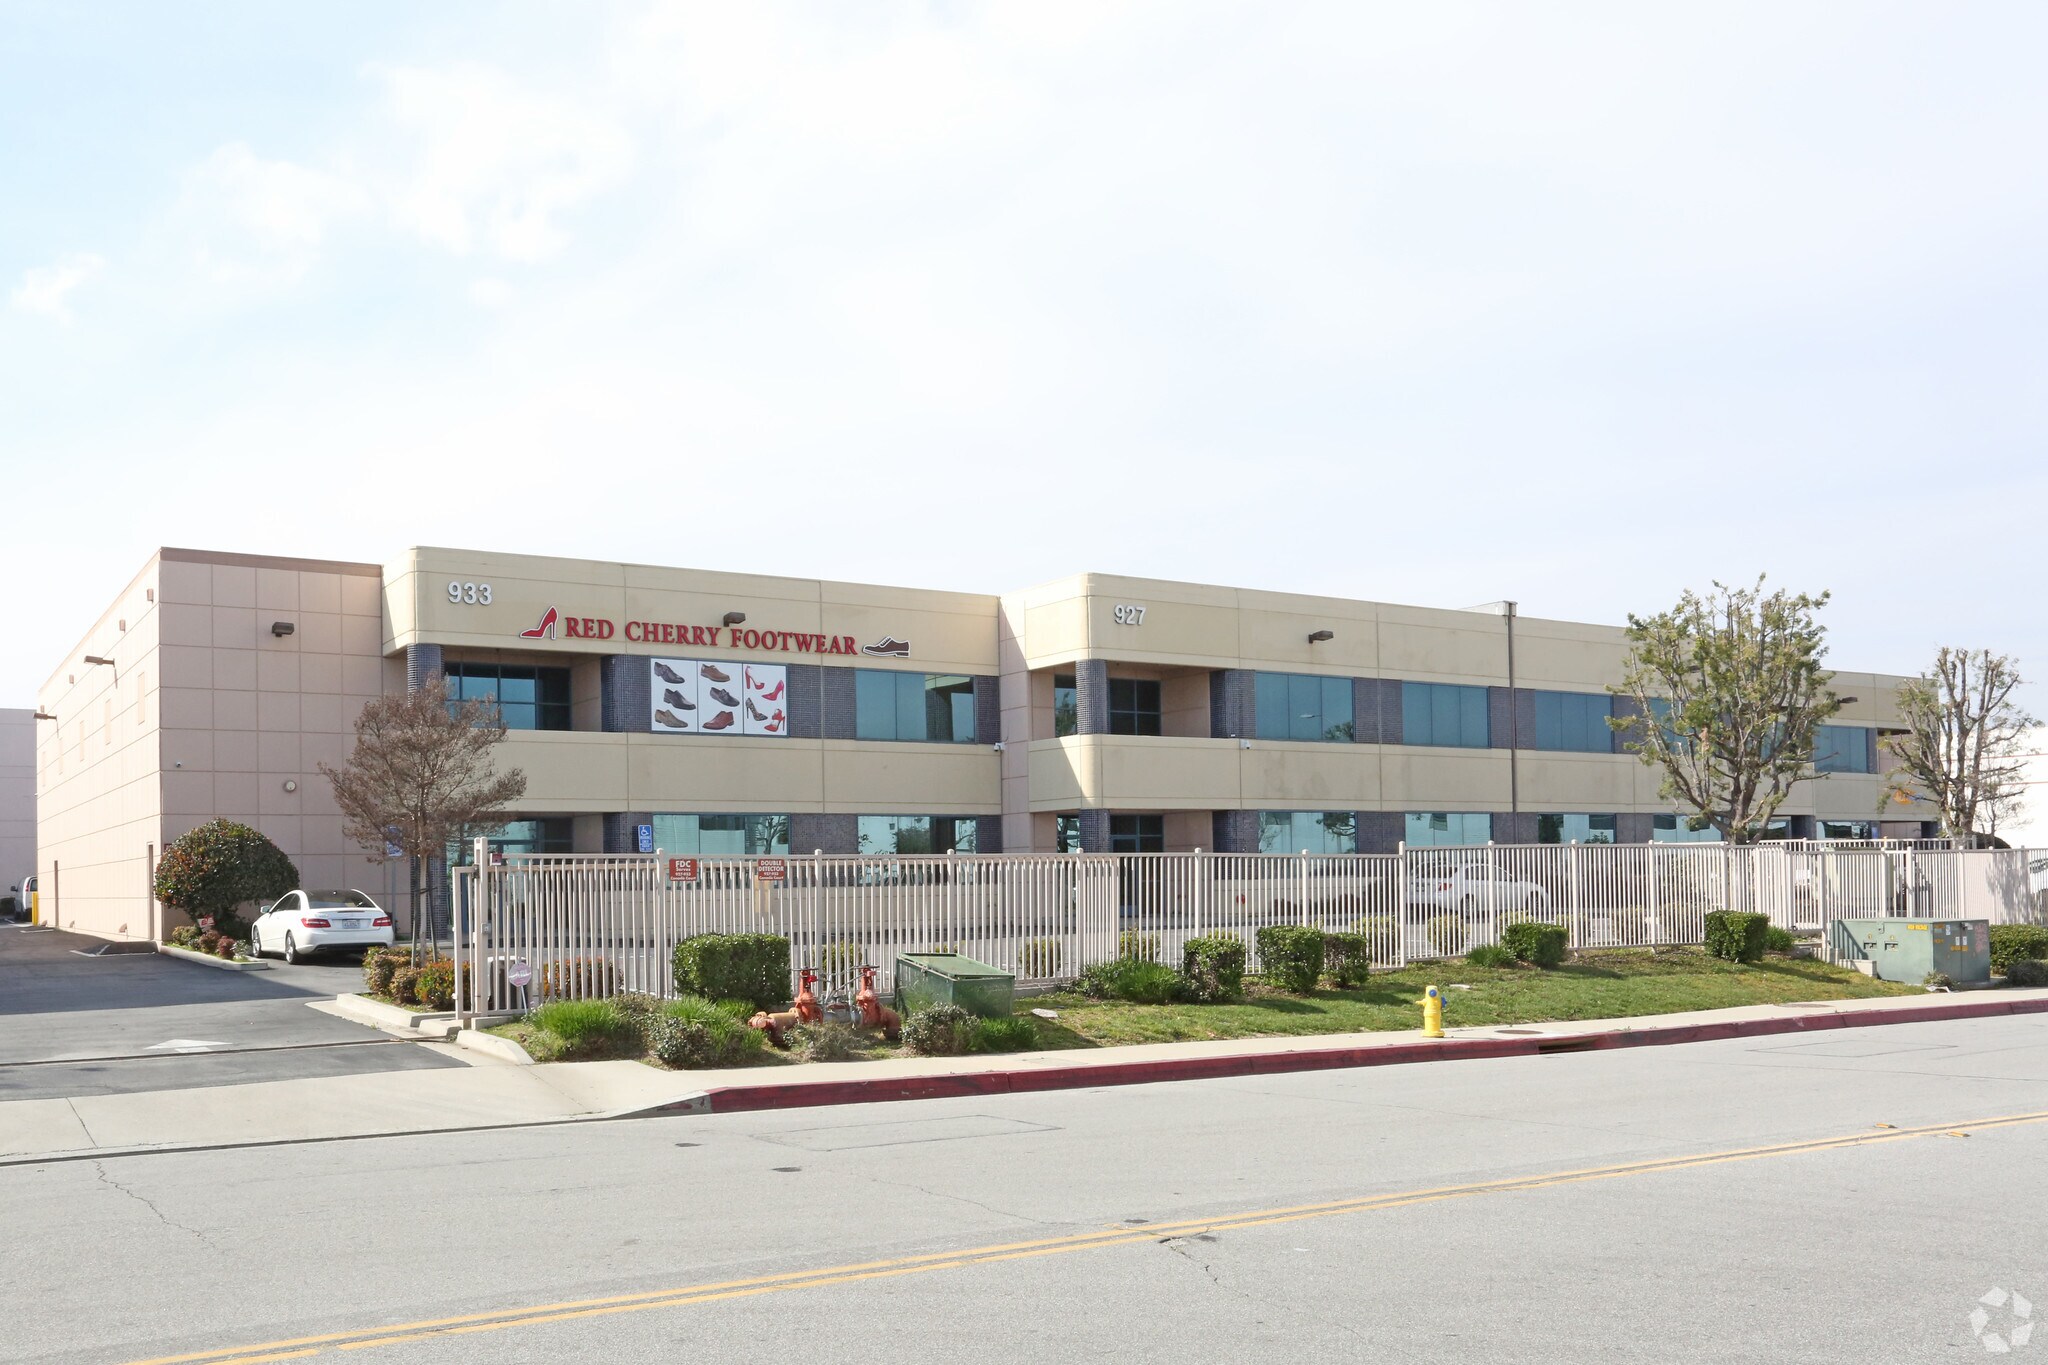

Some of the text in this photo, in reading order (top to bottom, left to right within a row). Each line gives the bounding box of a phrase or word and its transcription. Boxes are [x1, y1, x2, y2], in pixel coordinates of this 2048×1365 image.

[448, 581, 492, 606] 933
[1114, 604, 1147, 626] 927
[565, 617, 858, 656] RED CHERRY FOOTWEAR
[675, 860, 691, 868] FDC
